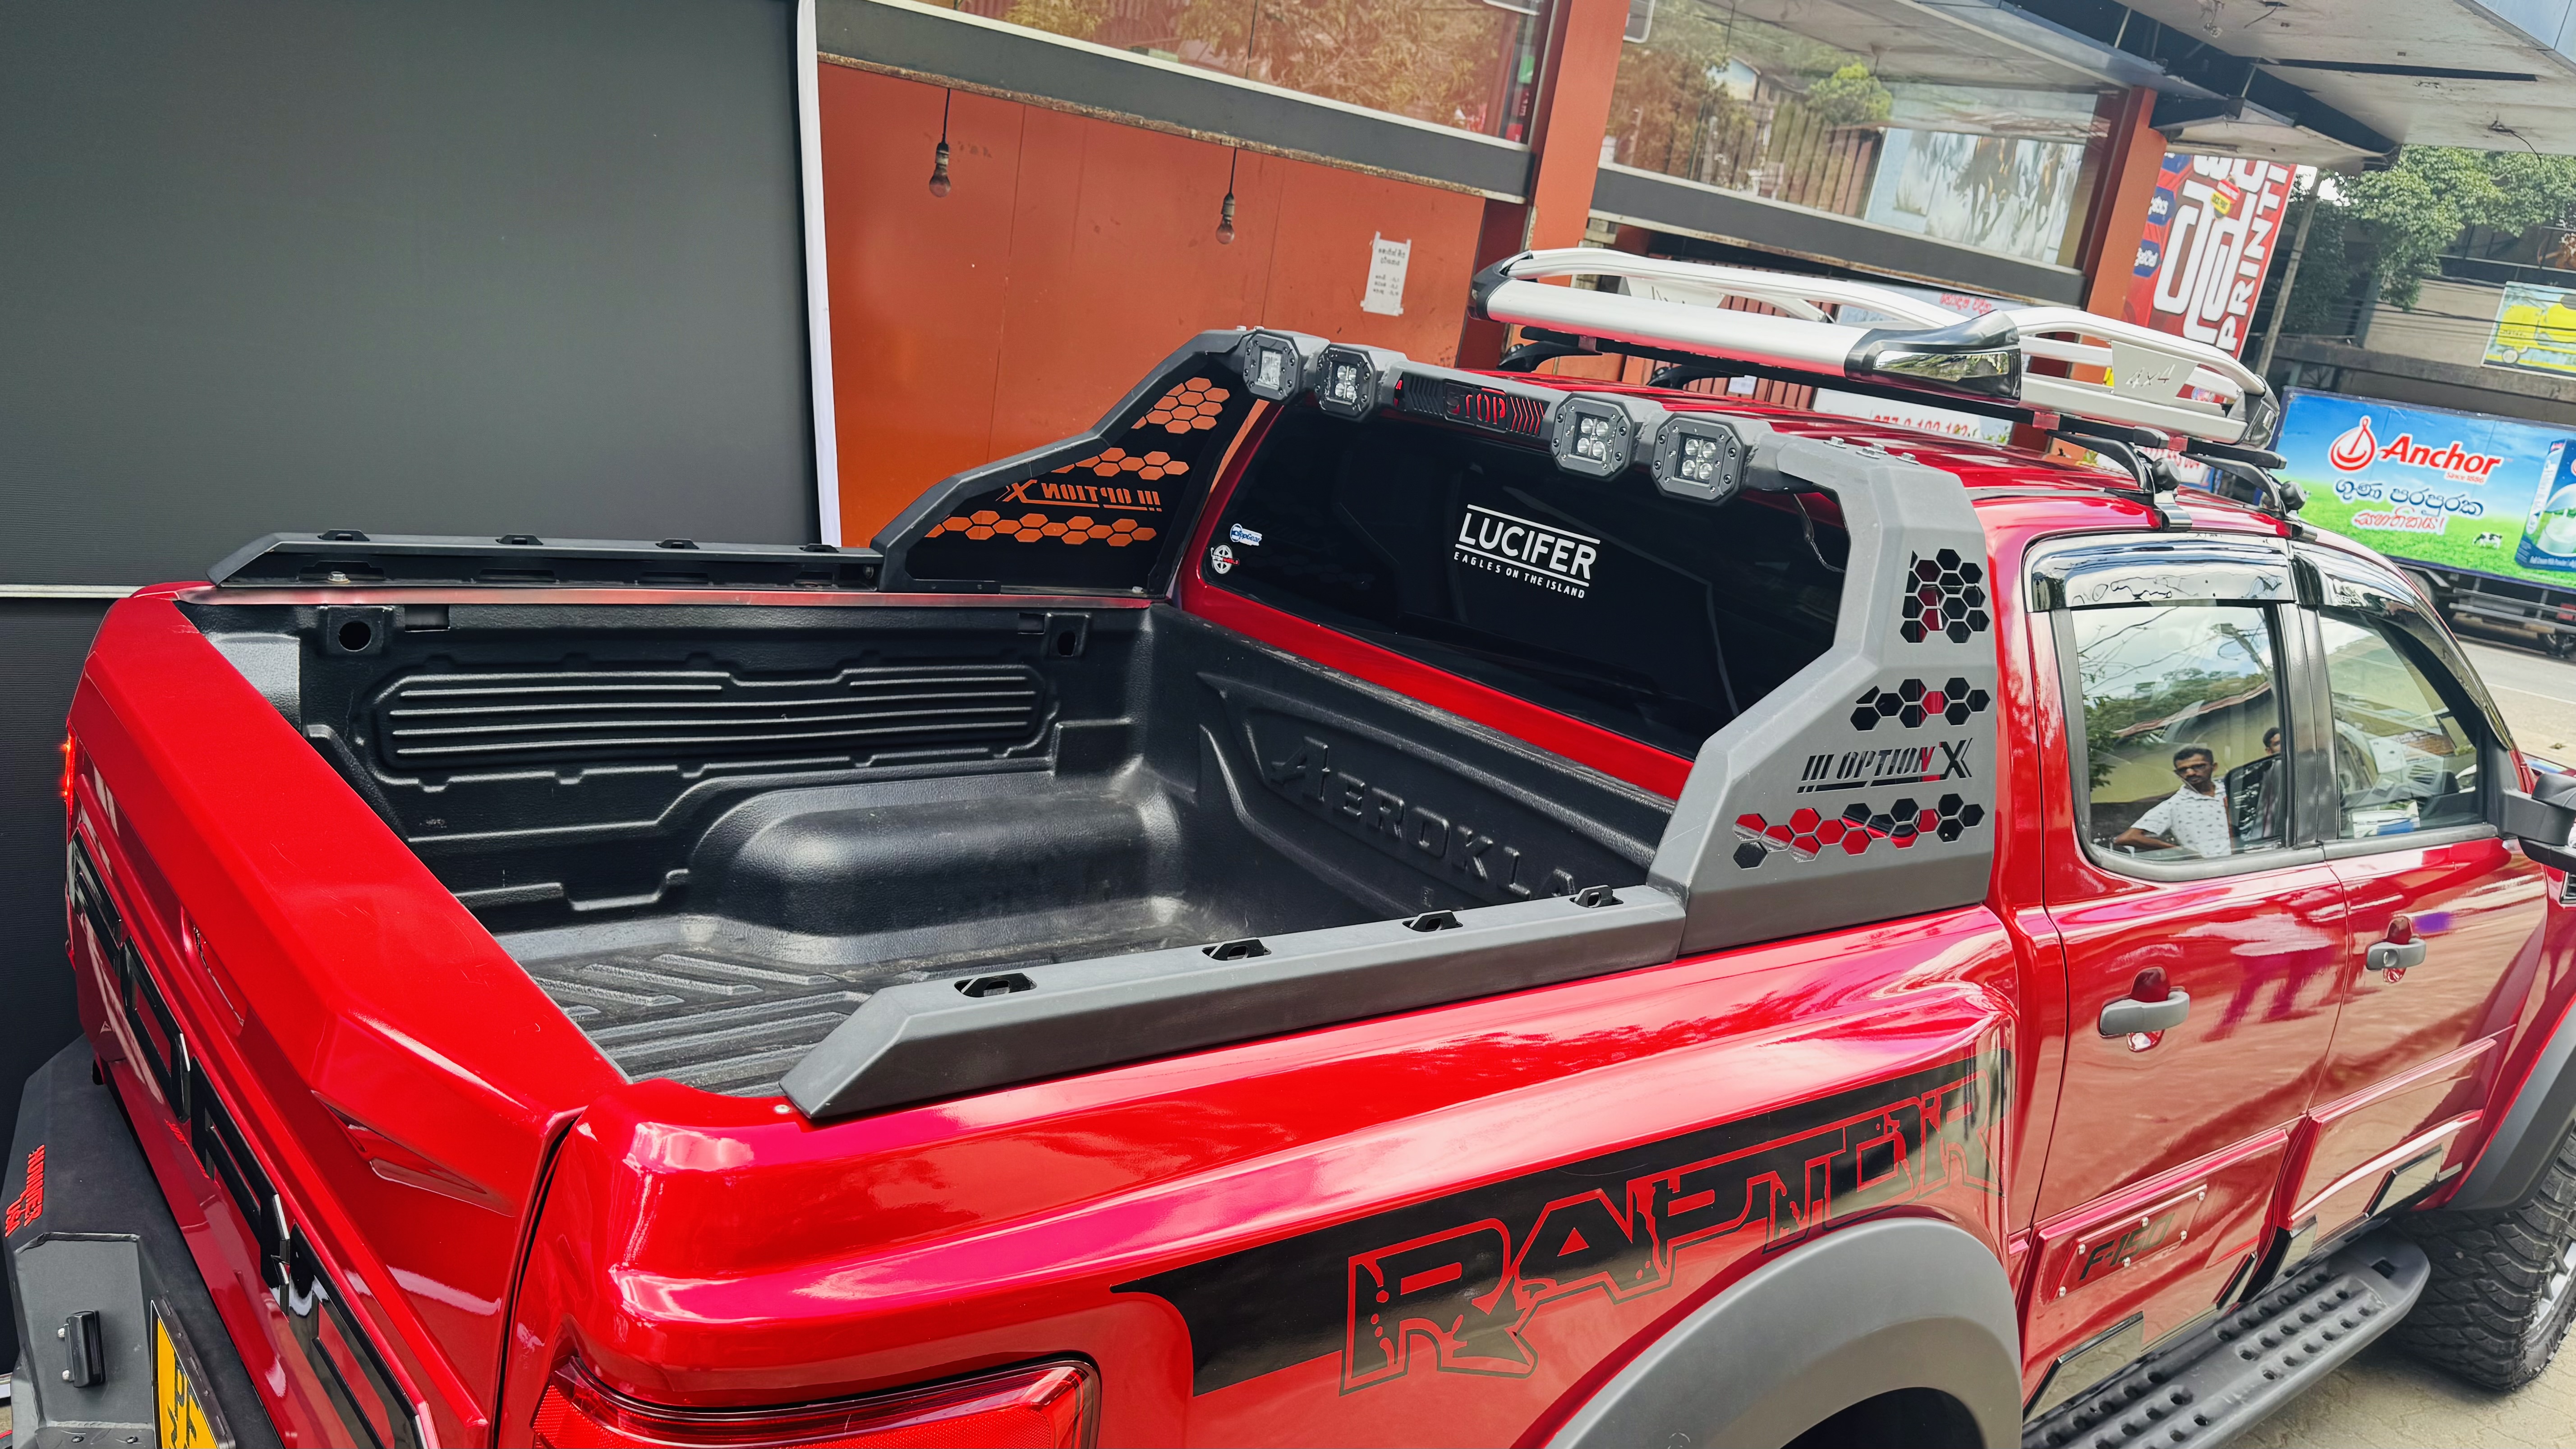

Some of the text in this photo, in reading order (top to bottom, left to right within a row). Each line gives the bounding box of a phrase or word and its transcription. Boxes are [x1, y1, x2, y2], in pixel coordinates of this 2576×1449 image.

[1446, 383, 1507, 425] STOP
[2380, 436, 2502, 475] Anchor
[2336, 479, 2383, 501] ගුණ
[1458, 512, 1597, 580] LUCIFER
[1454, 551, 1585, 599] EAGLES ON THE ISLAND
[1836, 746, 1936, 780] OPTION
[1339, 1068, 2005, 1396] RAPTOR
[2078, 1212, 2176, 1281] F-150
